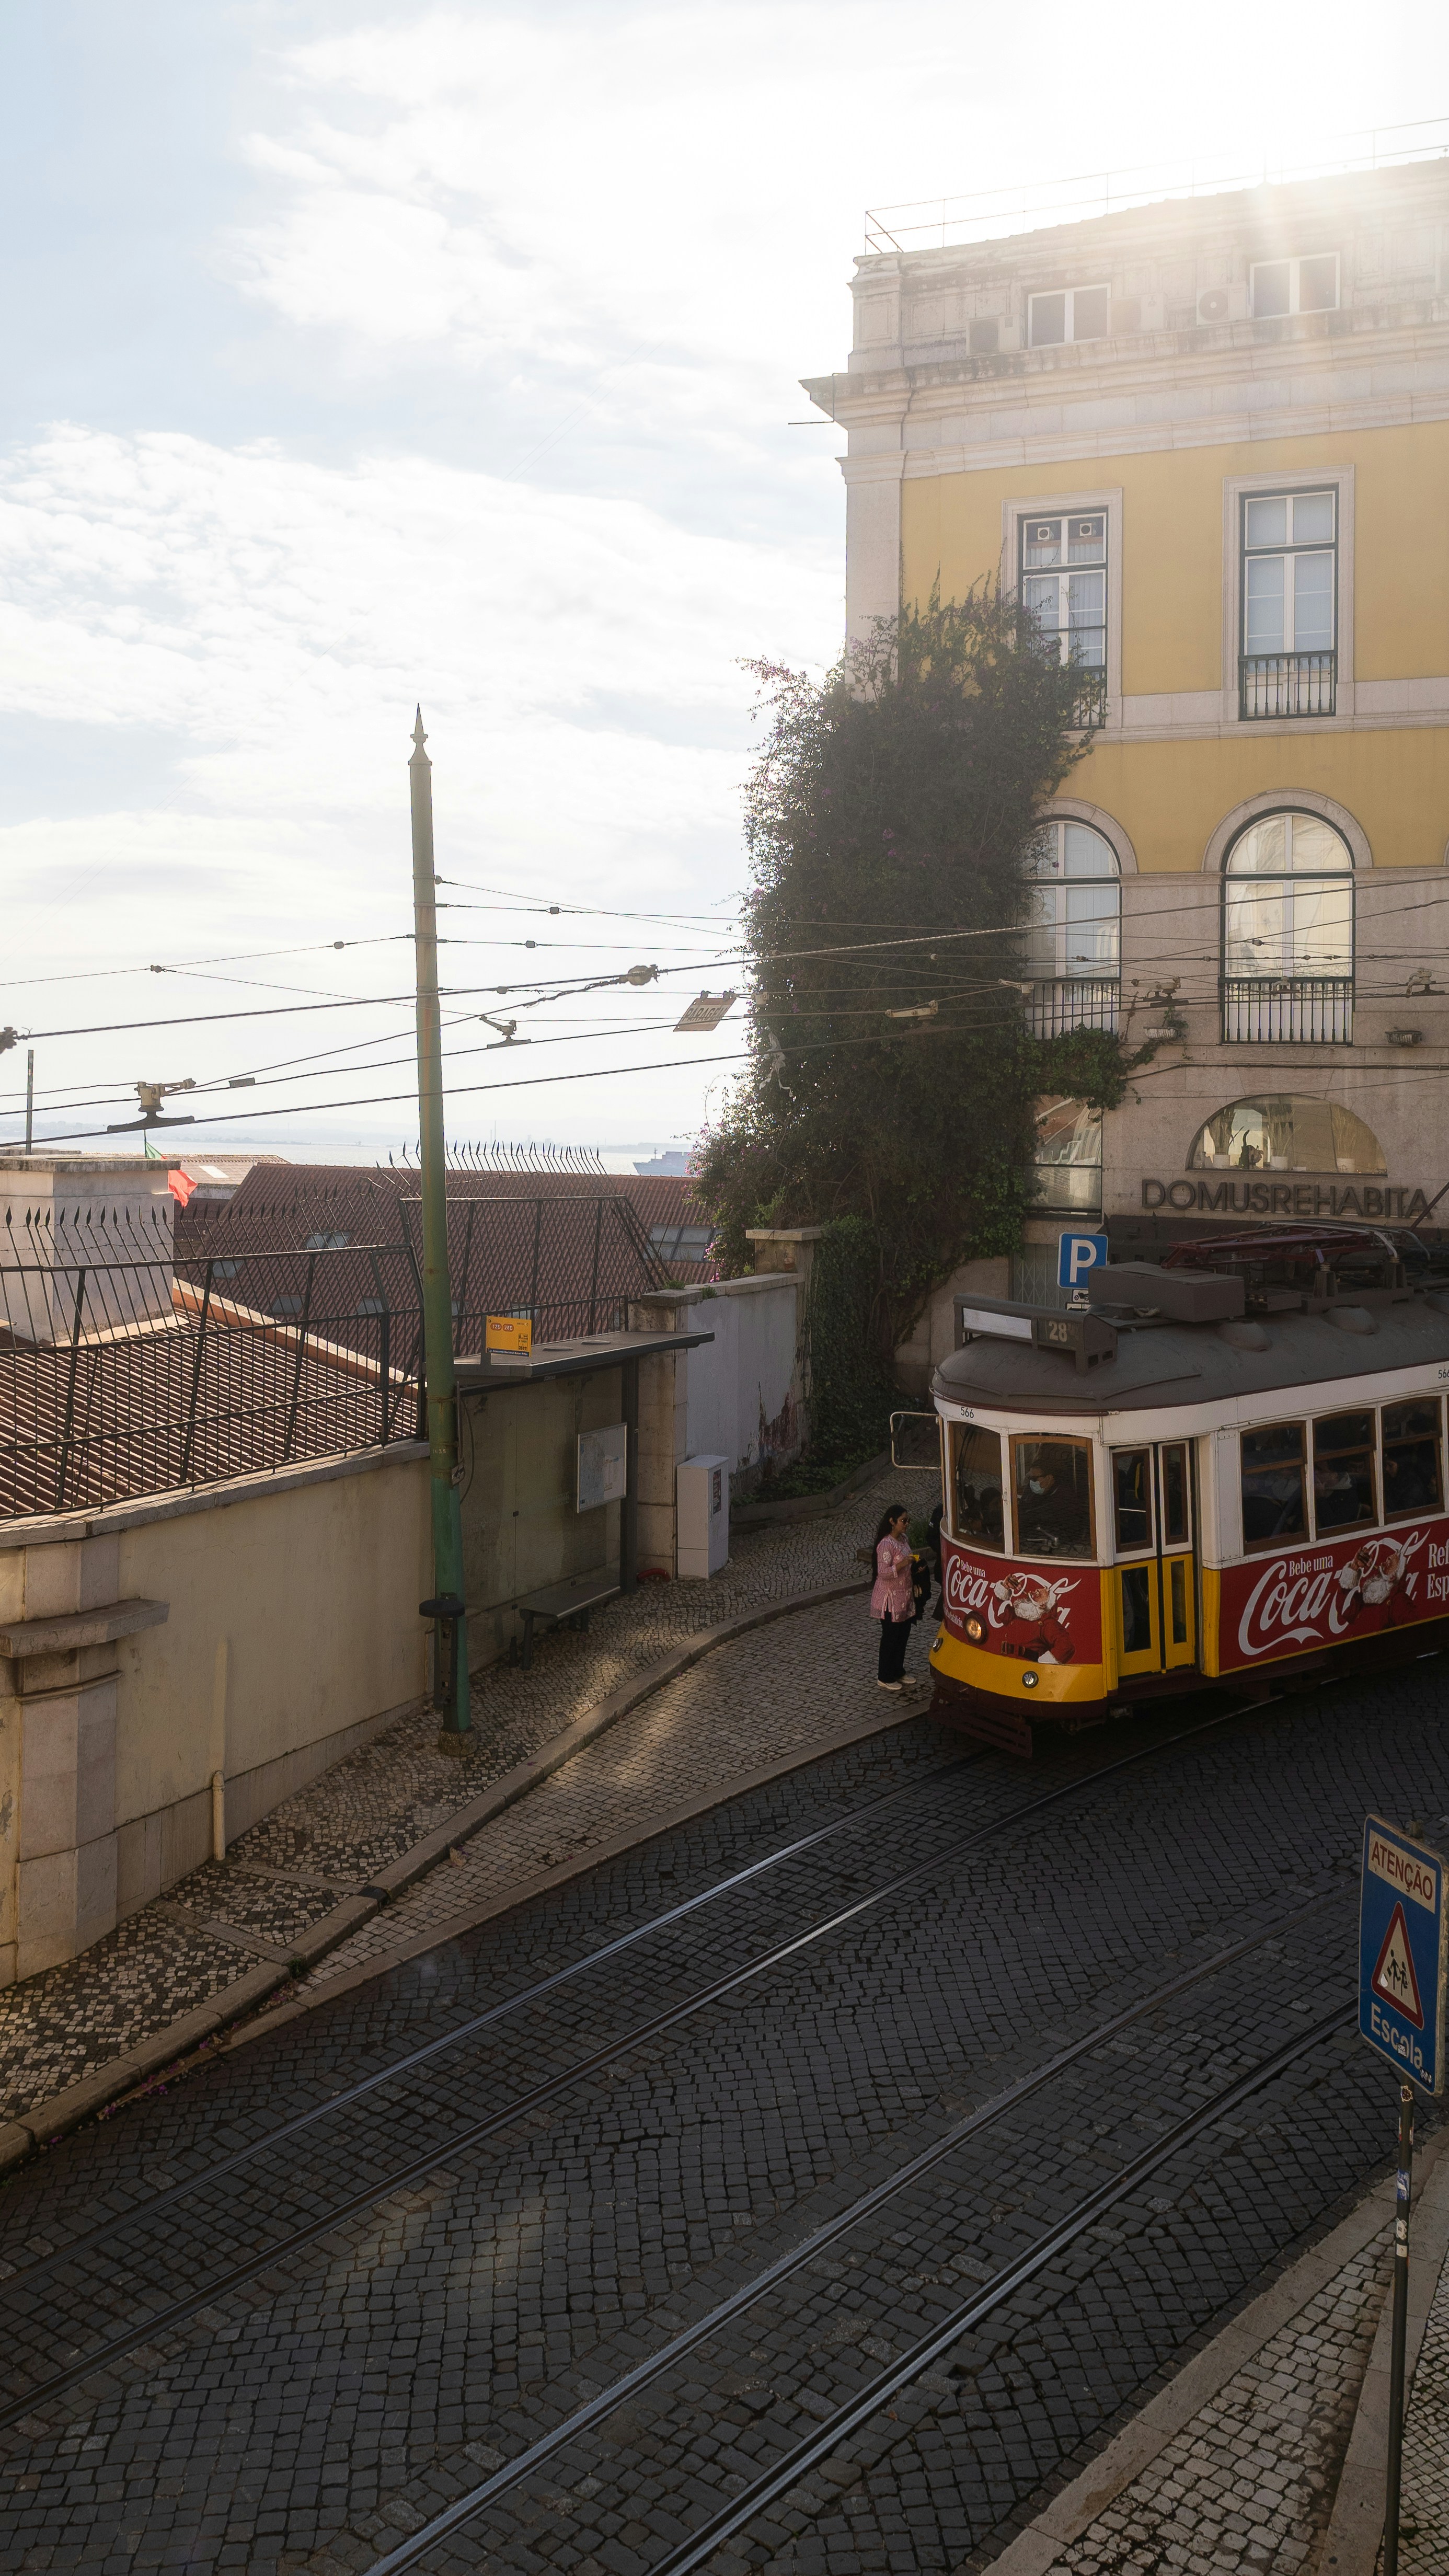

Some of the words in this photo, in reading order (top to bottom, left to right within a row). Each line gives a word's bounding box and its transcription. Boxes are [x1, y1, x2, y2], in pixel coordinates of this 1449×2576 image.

[1141, 1179, 1432, 1220] DOMUSREHABITA
[1070, 1239, 1097, 1283] P
[961, 1407, 974, 1419] 566
[961, 1559, 973, 1574] Bebe
[973, 1566, 986, 1578] uma
[1289, 1558, 1312, 1577] Bebe
[1314, 1555, 1333, 1571] uma
[1371, 1841, 1433, 1901] ATENÇÃO
[1371, 2002, 1423, 2070] Escola
